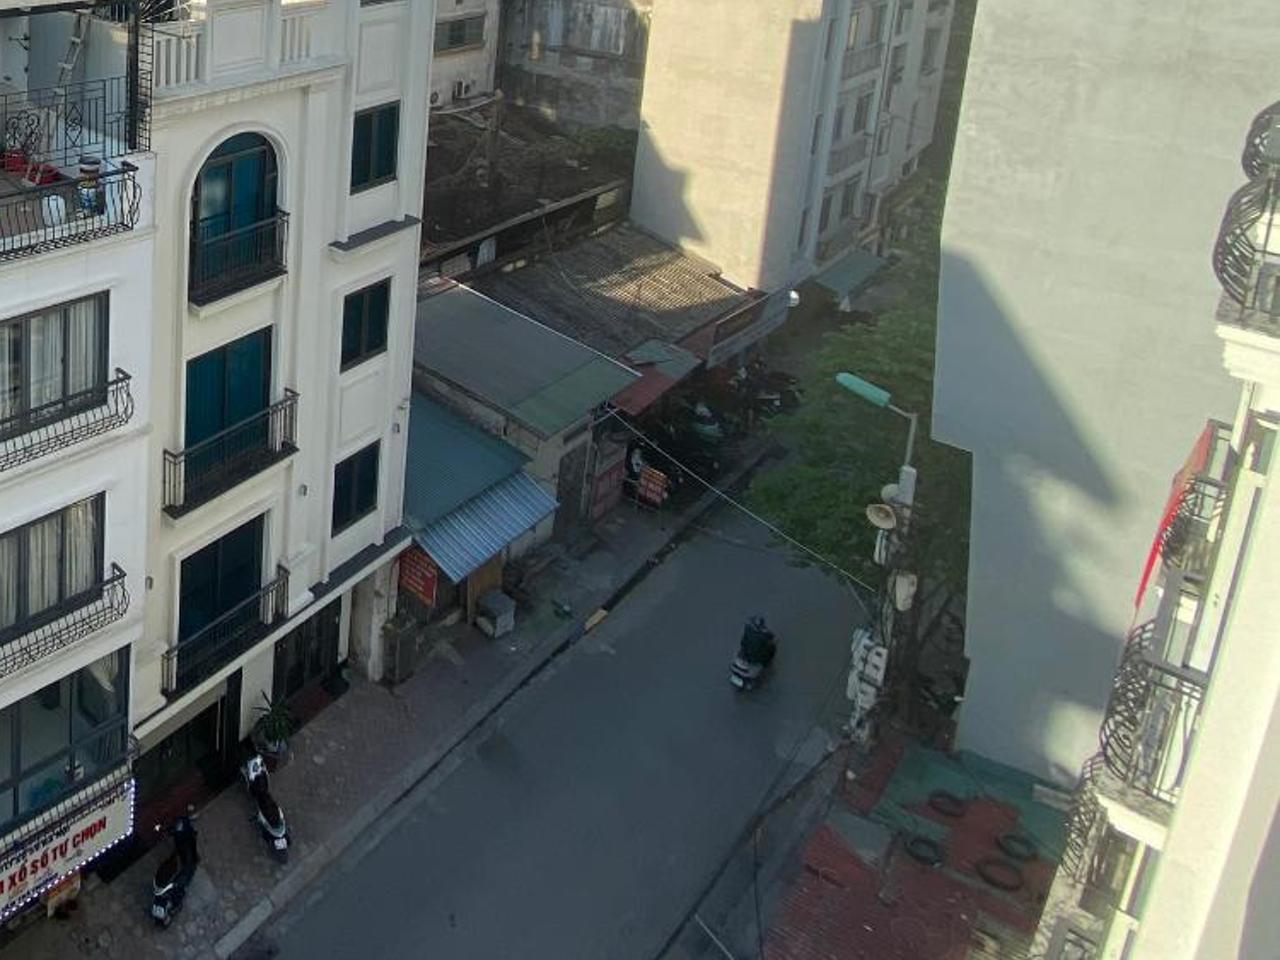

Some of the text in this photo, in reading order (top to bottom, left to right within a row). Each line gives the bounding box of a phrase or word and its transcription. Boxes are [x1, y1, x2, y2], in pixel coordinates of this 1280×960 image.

[8, 860, 27, 888] XỔ
[30, 851, 49, 876] SỐ
[72, 817, 106, 848] CHỌN
